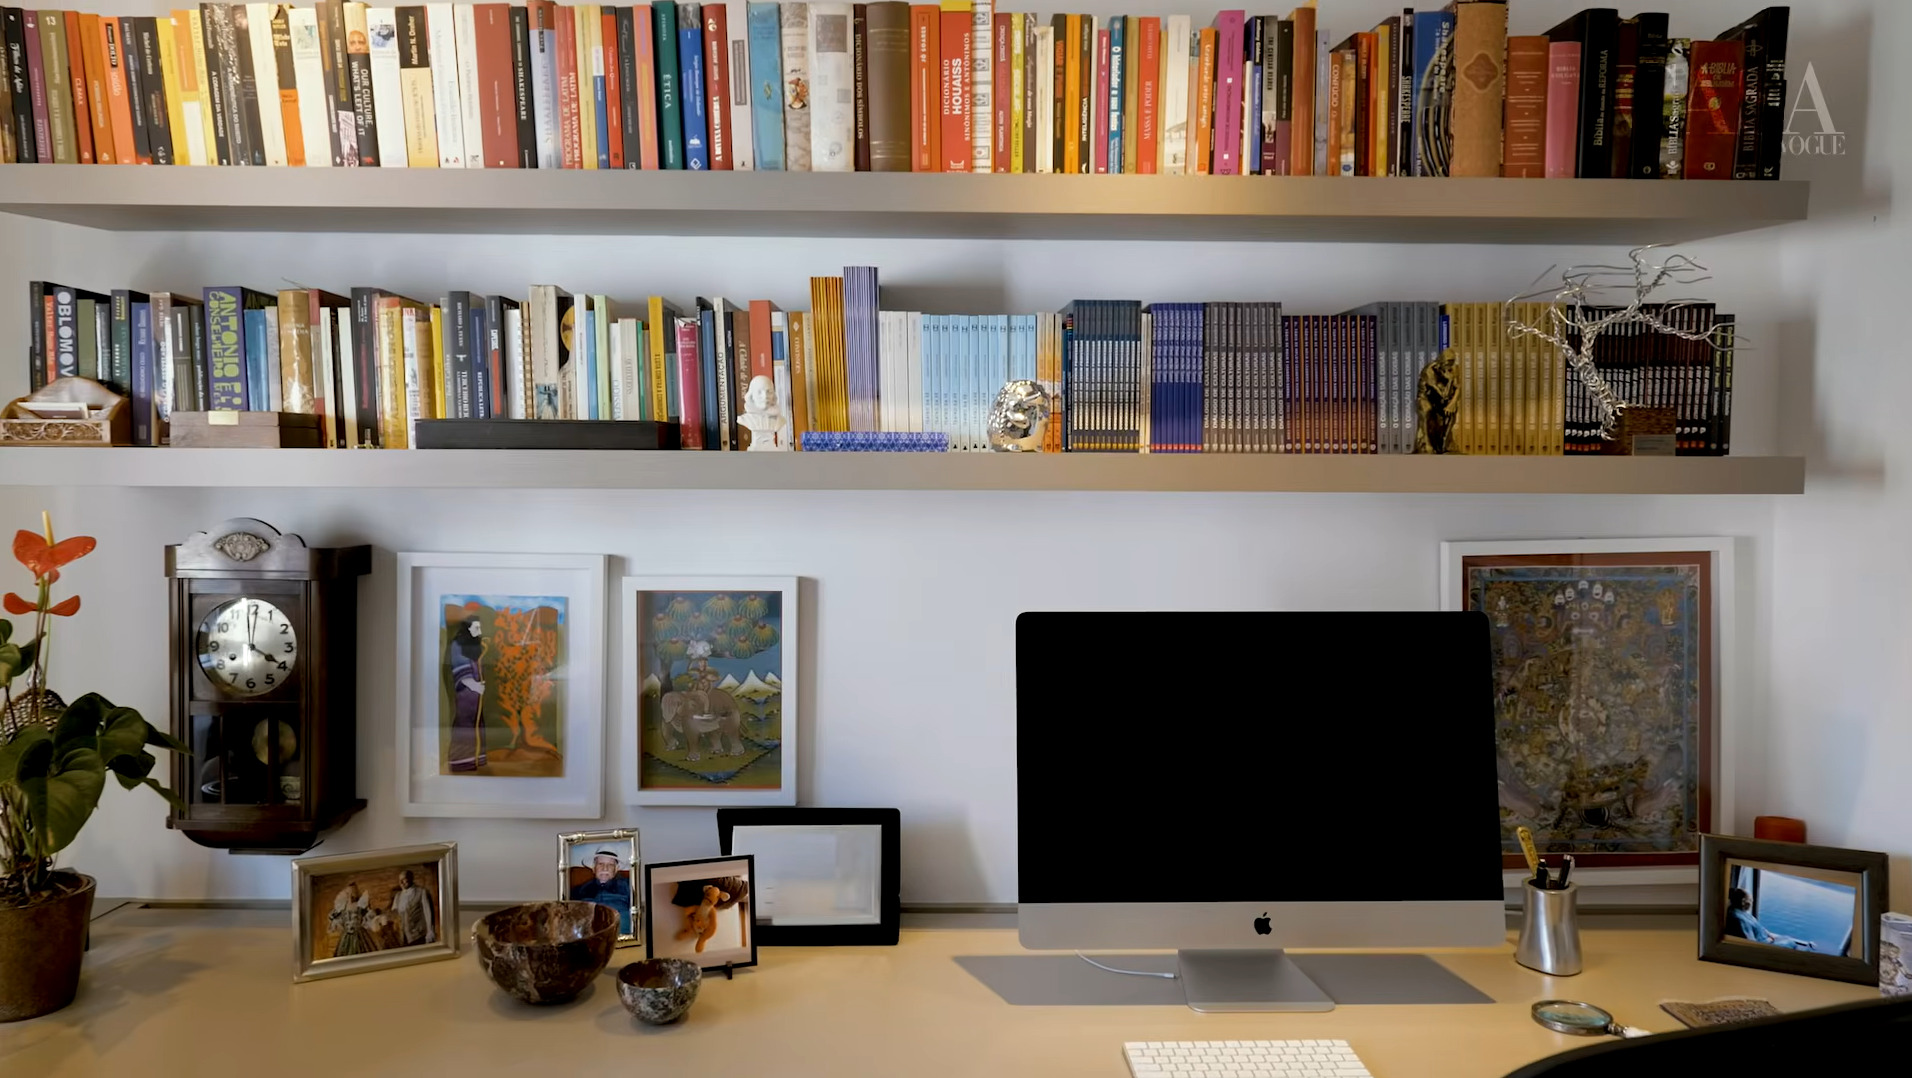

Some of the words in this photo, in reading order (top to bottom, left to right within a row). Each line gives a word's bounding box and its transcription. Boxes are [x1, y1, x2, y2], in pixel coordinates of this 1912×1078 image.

[1254, 18, 1262, 41] Anthony
[410, 45, 419, 65] Martin
[855, 33, 864, 81] DICIONÁRIO
[962, 33, 970, 83] ANTÔNIMOS
[1438, 21, 1450, 93] Shakespeare
[351, 61, 361, 91] WHAT'S
[360, 68, 370, 86] OUR
[942, 59, 950, 115] DICIONÁRIO
[952, 58, 962, 115] HOUAISS
[1331, 64, 1341, 107] CONFÚCIO
[354, 94, 362, 112] LEFT
[517, 67, 528, 121] SHAKESPEARE
[662, 73, 673, 109] ÉTICA
[1144, 80, 1152, 107] PODER
[1400, 75, 1411, 123] SHAKESPEARE
[1743, 66, 1759, 116] SAGRADA
[356, 116, 364, 125] OF
[856, 99, 865, 139] SÍMBOLOS
[962, 93, 971, 141] SINÔNIMOS
[1143, 115, 1151, 140] MASSA
[358, 128, 366, 136] IT
[563, 120, 573, 166] PROGRAMA
[571, 115, 581, 161] PROGRAMA
[1592, 118, 1604, 146] Bíblia
[208, 291, 224, 378] CONSELHEIRO
[219, 291, 240, 378] ANTONIO
[739, 349, 748, 370] Cidade
[717, 352, 727, 424] ARGUMENTAÇÃO
[230, 609, 240, 620] 11
[247, 604, 259, 615] 12
[268, 609, 273, 621] 1
[217, 622, 229, 633] 10
[280, 623, 289, 635] 2
[209, 640, 220, 652] 9
[284, 642, 294, 653] 3
[216, 659, 225, 670] 8
[276, 660, 288, 671] 4
[229, 673, 238, 684] 7
[246, 678, 256, 689] 6
[264, 673, 275, 685] 5
